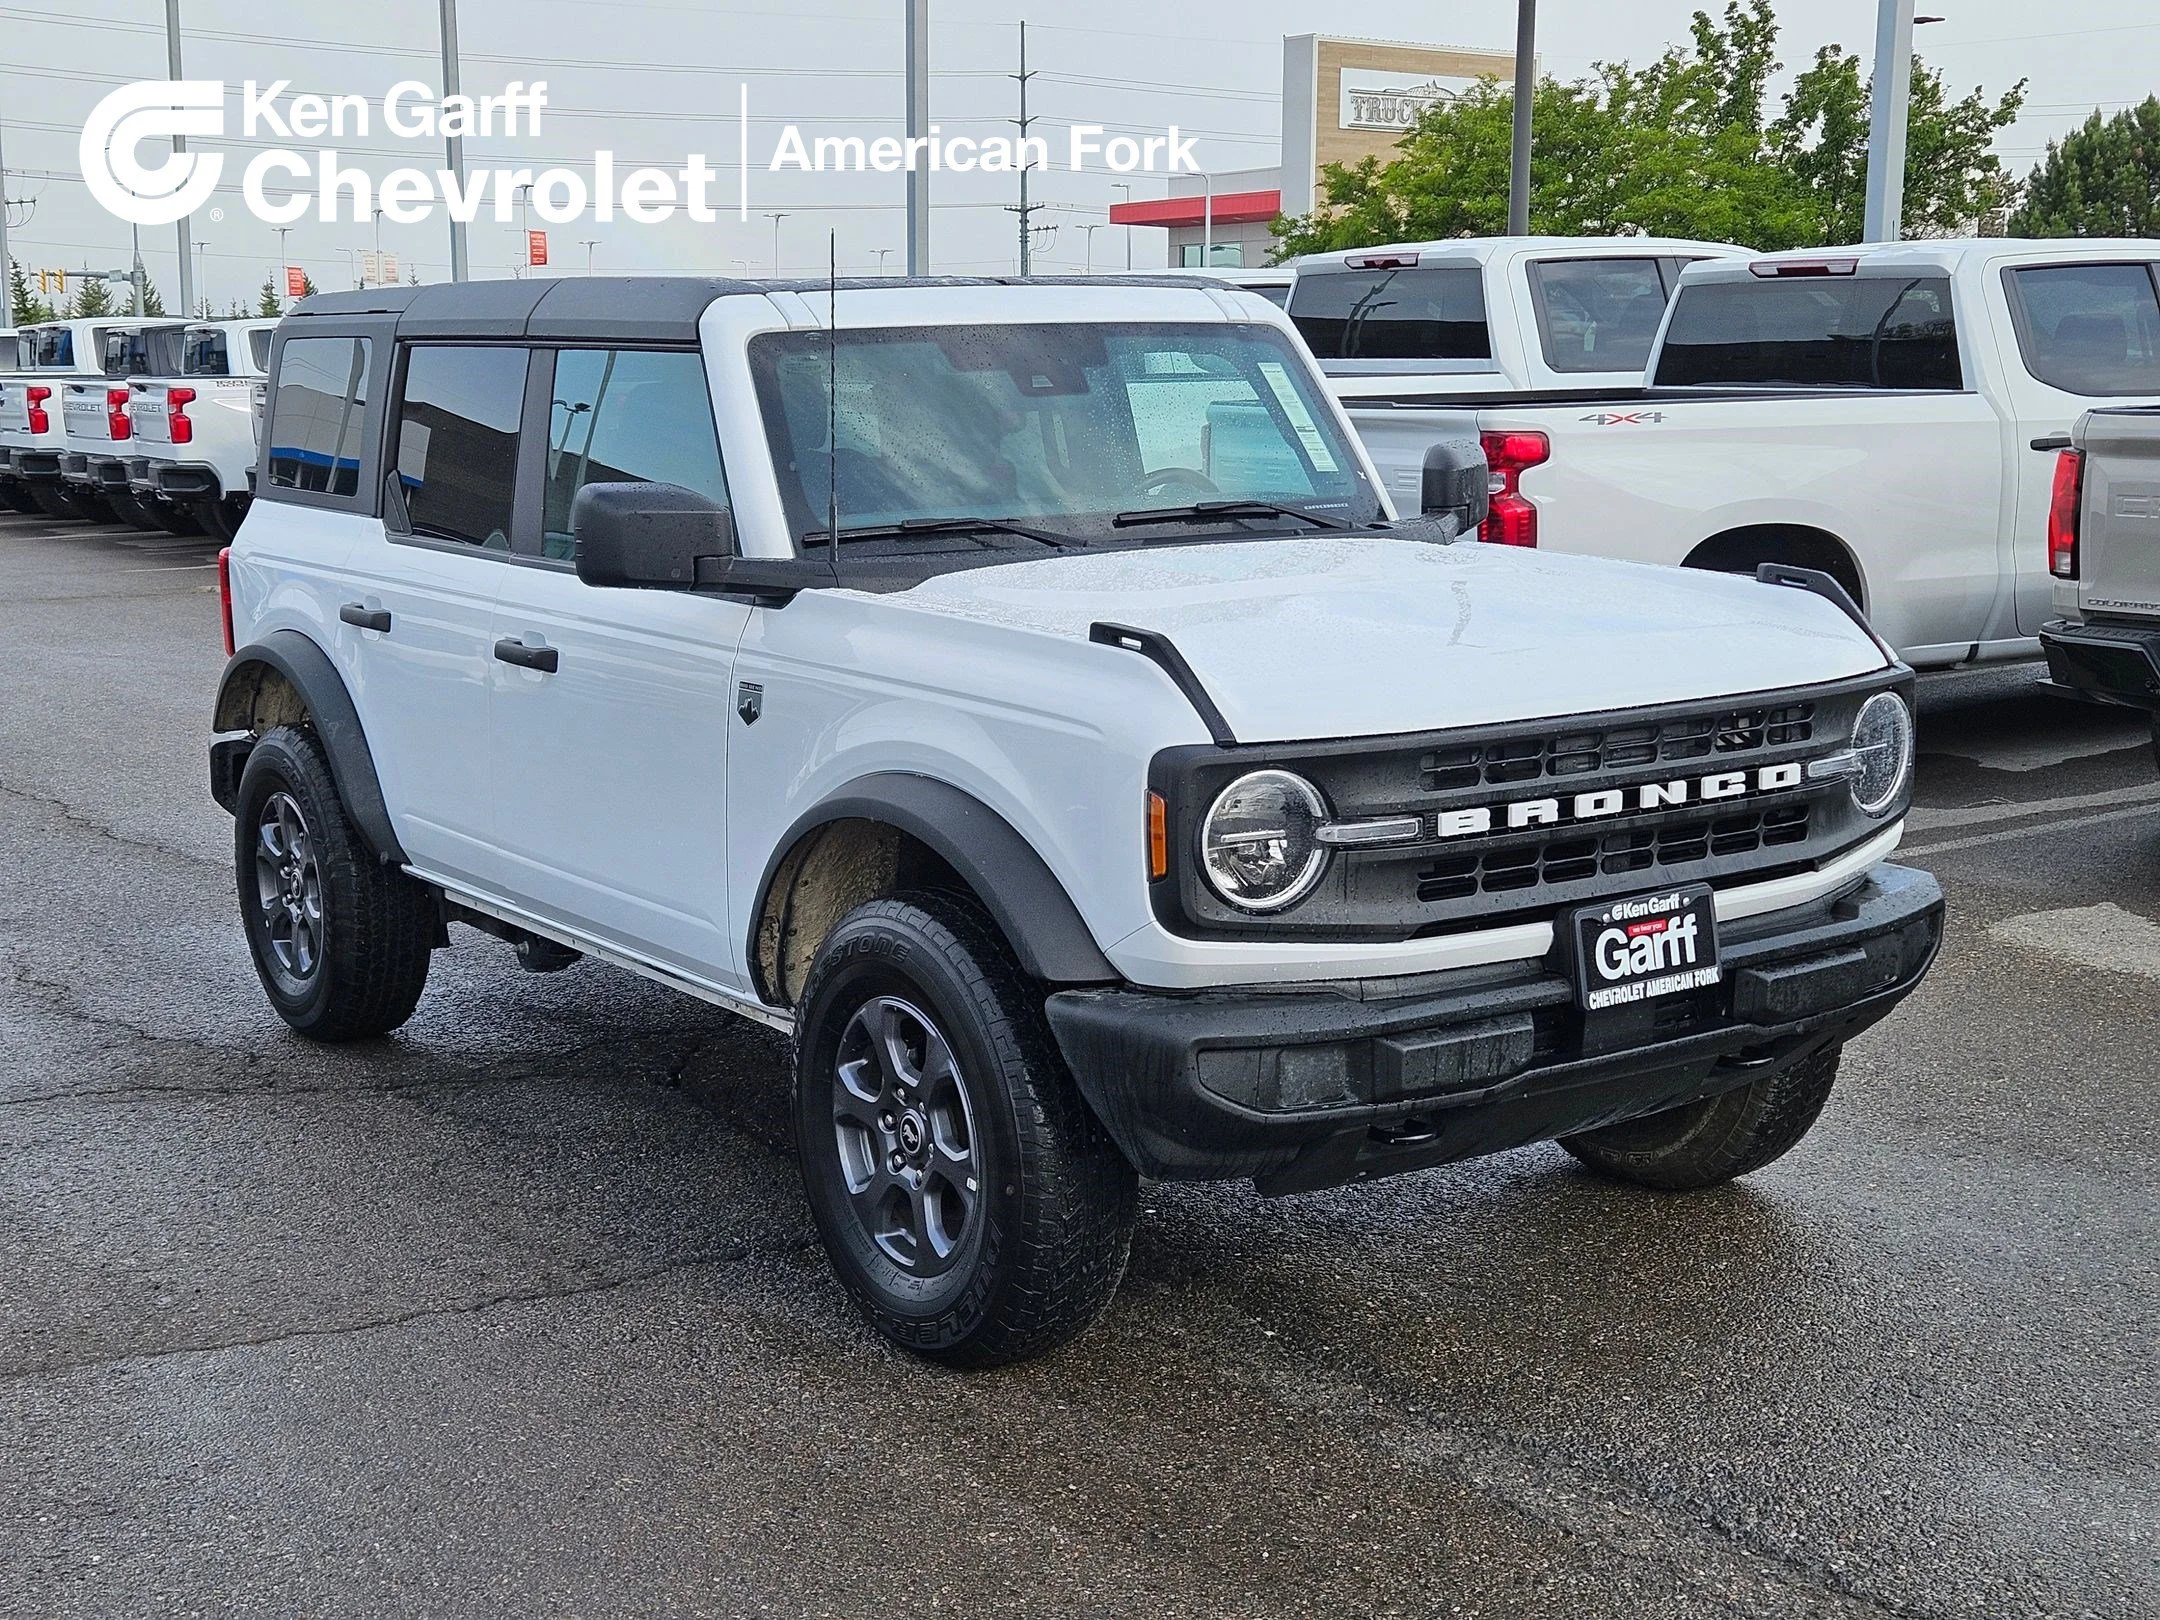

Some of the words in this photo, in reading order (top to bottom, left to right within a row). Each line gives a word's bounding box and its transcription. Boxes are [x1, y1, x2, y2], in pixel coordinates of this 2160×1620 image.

[1437, 762, 1802, 837] BRONCO
[1623, 901, 1648, 919] Ken
[1649, 893, 1680, 912] Garff
[1595, 913, 1698, 981] Garff
[1588, 983, 1645, 1010] CHEVROLET
[1646, 973, 1694, 998] AMERICAN
[1694, 967, 1720, 988] FORK
